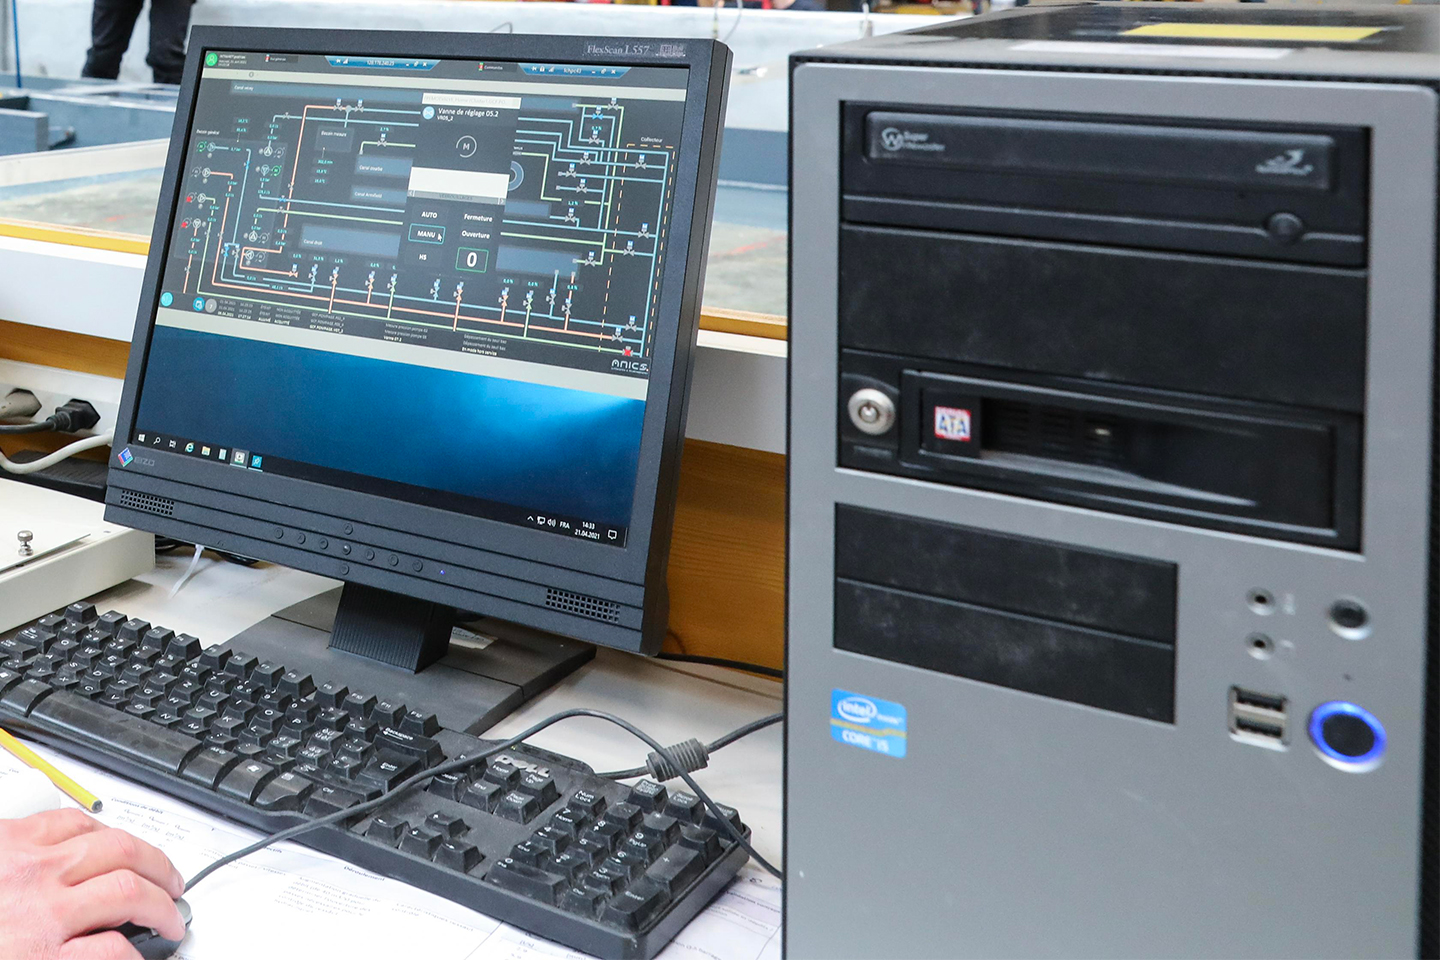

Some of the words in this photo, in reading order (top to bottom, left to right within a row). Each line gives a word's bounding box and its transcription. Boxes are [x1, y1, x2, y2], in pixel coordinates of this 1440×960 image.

[587, 44, 623, 55] FlexScan
[421, 211, 438, 219] AUTO
[464, 214, 493, 222] Fermeture
[417, 230, 436, 238] MANU
[462, 230, 491, 239] Ouverture
[466, 251, 478, 267] 0
[939, 414, 966, 434] ATA
[559, 521, 570, 530] FRA
[575, 529, 600, 540] 21.04.2021
[351, 692, 363, 700] F10
[381, 701, 391, 709] F11
[842, 700, 872, 717] intel
[188, 722, 200, 730] M
[385, 726, 414, 741] Backspace
[492, 764, 509, 774] Home
[495, 754, 550, 778] DELL
[474, 782, 487, 790] End
[574, 793, 591, 803] Lock
[578, 790, 595, 799] Num
[555, 813, 573, 823] Home
[517, 844, 531, 852] End
[624, 891, 645, 901] Enter
